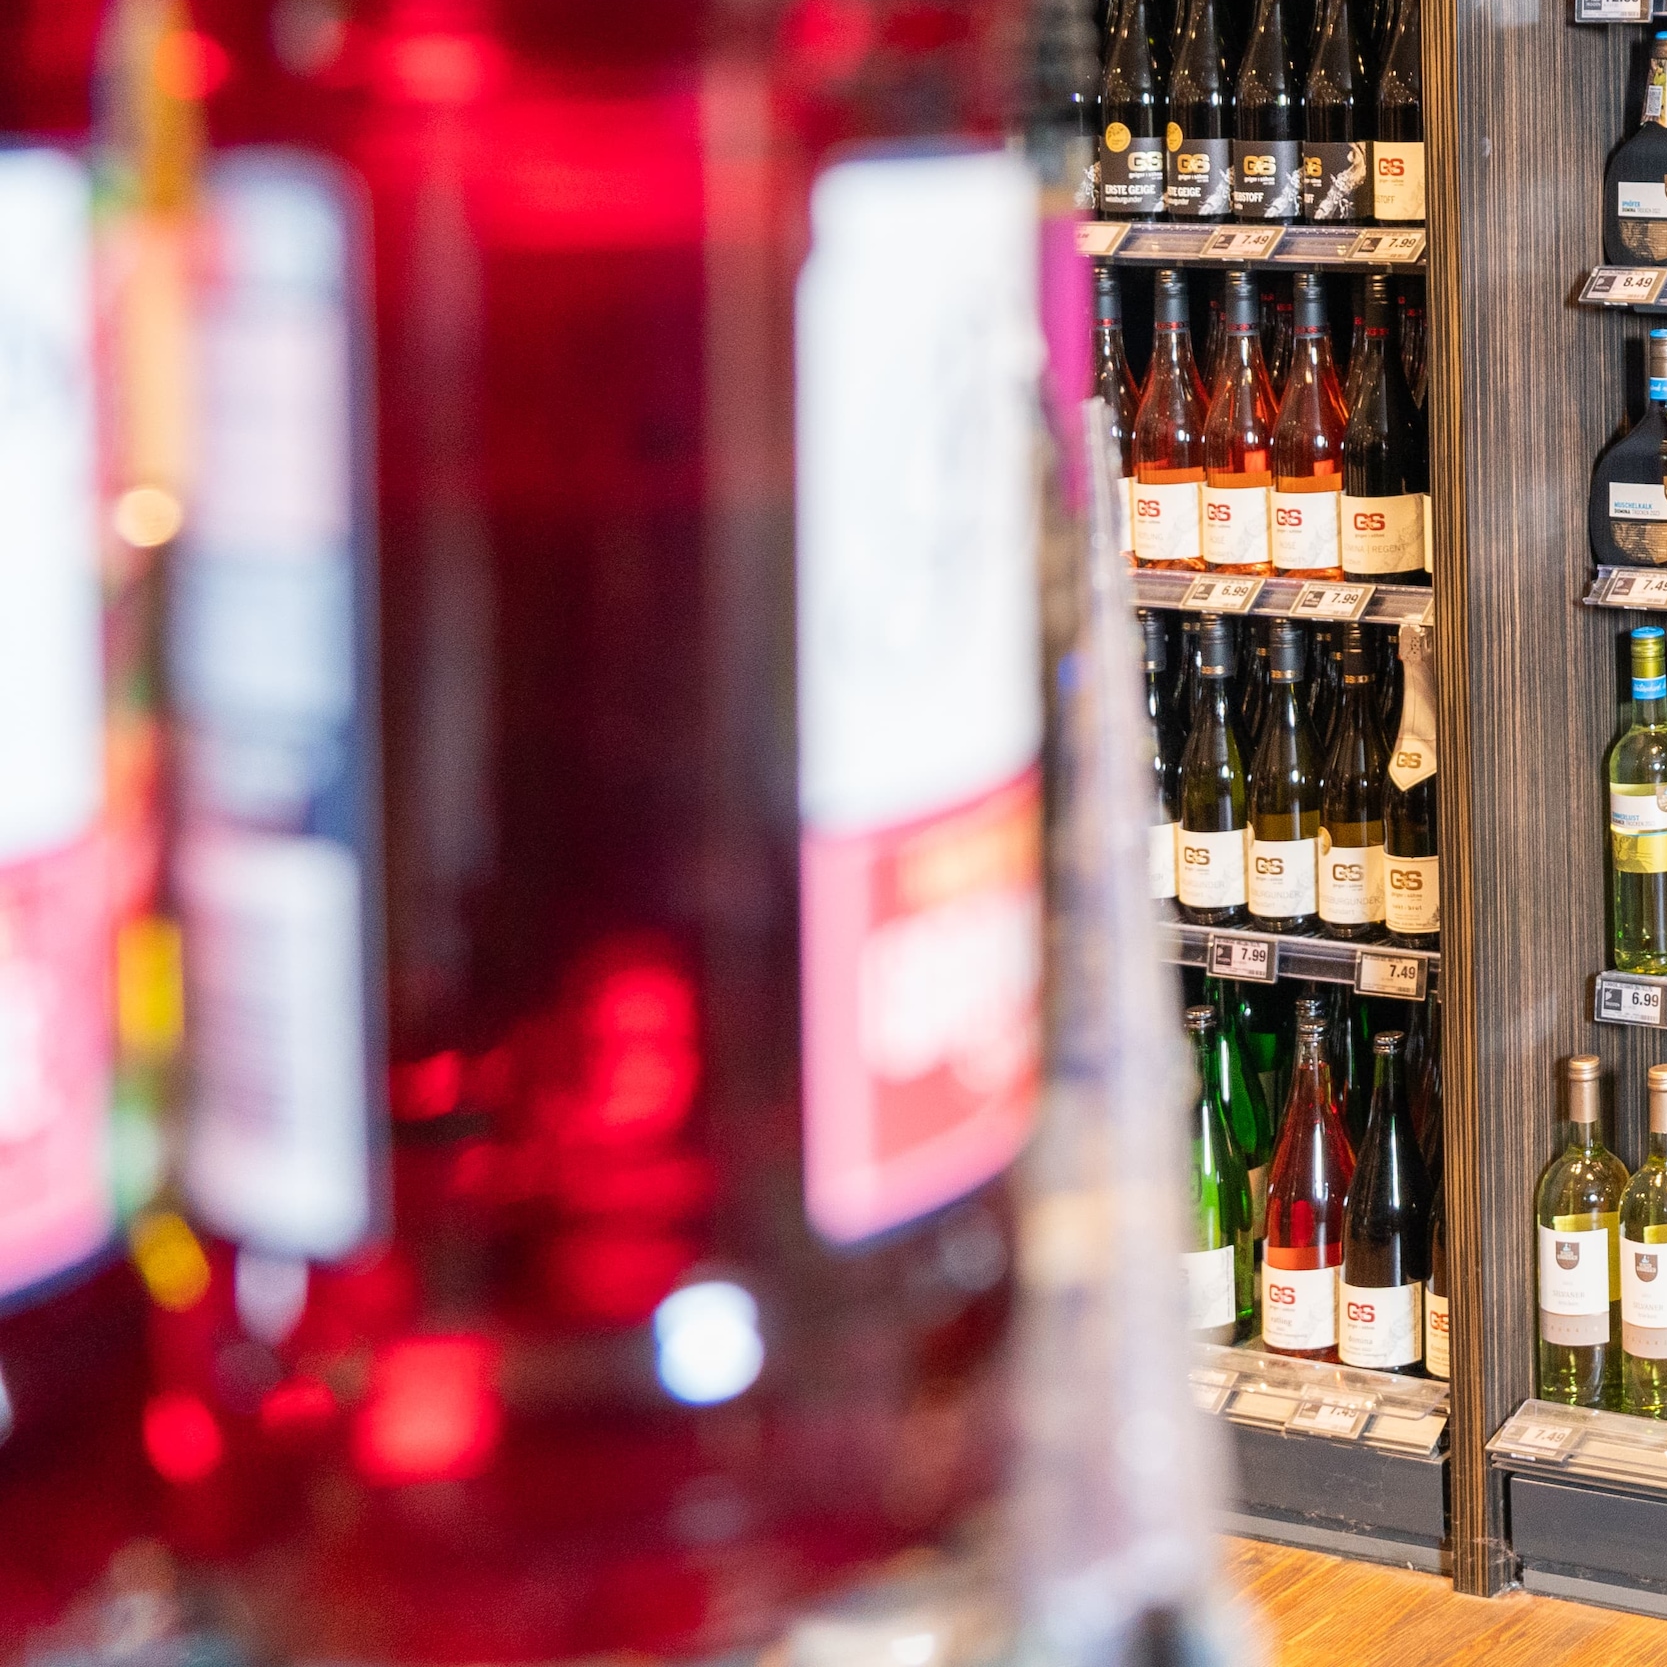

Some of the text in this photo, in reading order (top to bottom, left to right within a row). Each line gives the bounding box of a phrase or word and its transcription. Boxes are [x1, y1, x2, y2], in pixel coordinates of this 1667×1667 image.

[1105, 185, 1156, 196] ERSTE GEIGE
[1389, 963, 1416, 980] 7.49
[1632, 991, 1660, 1008] 6.99
